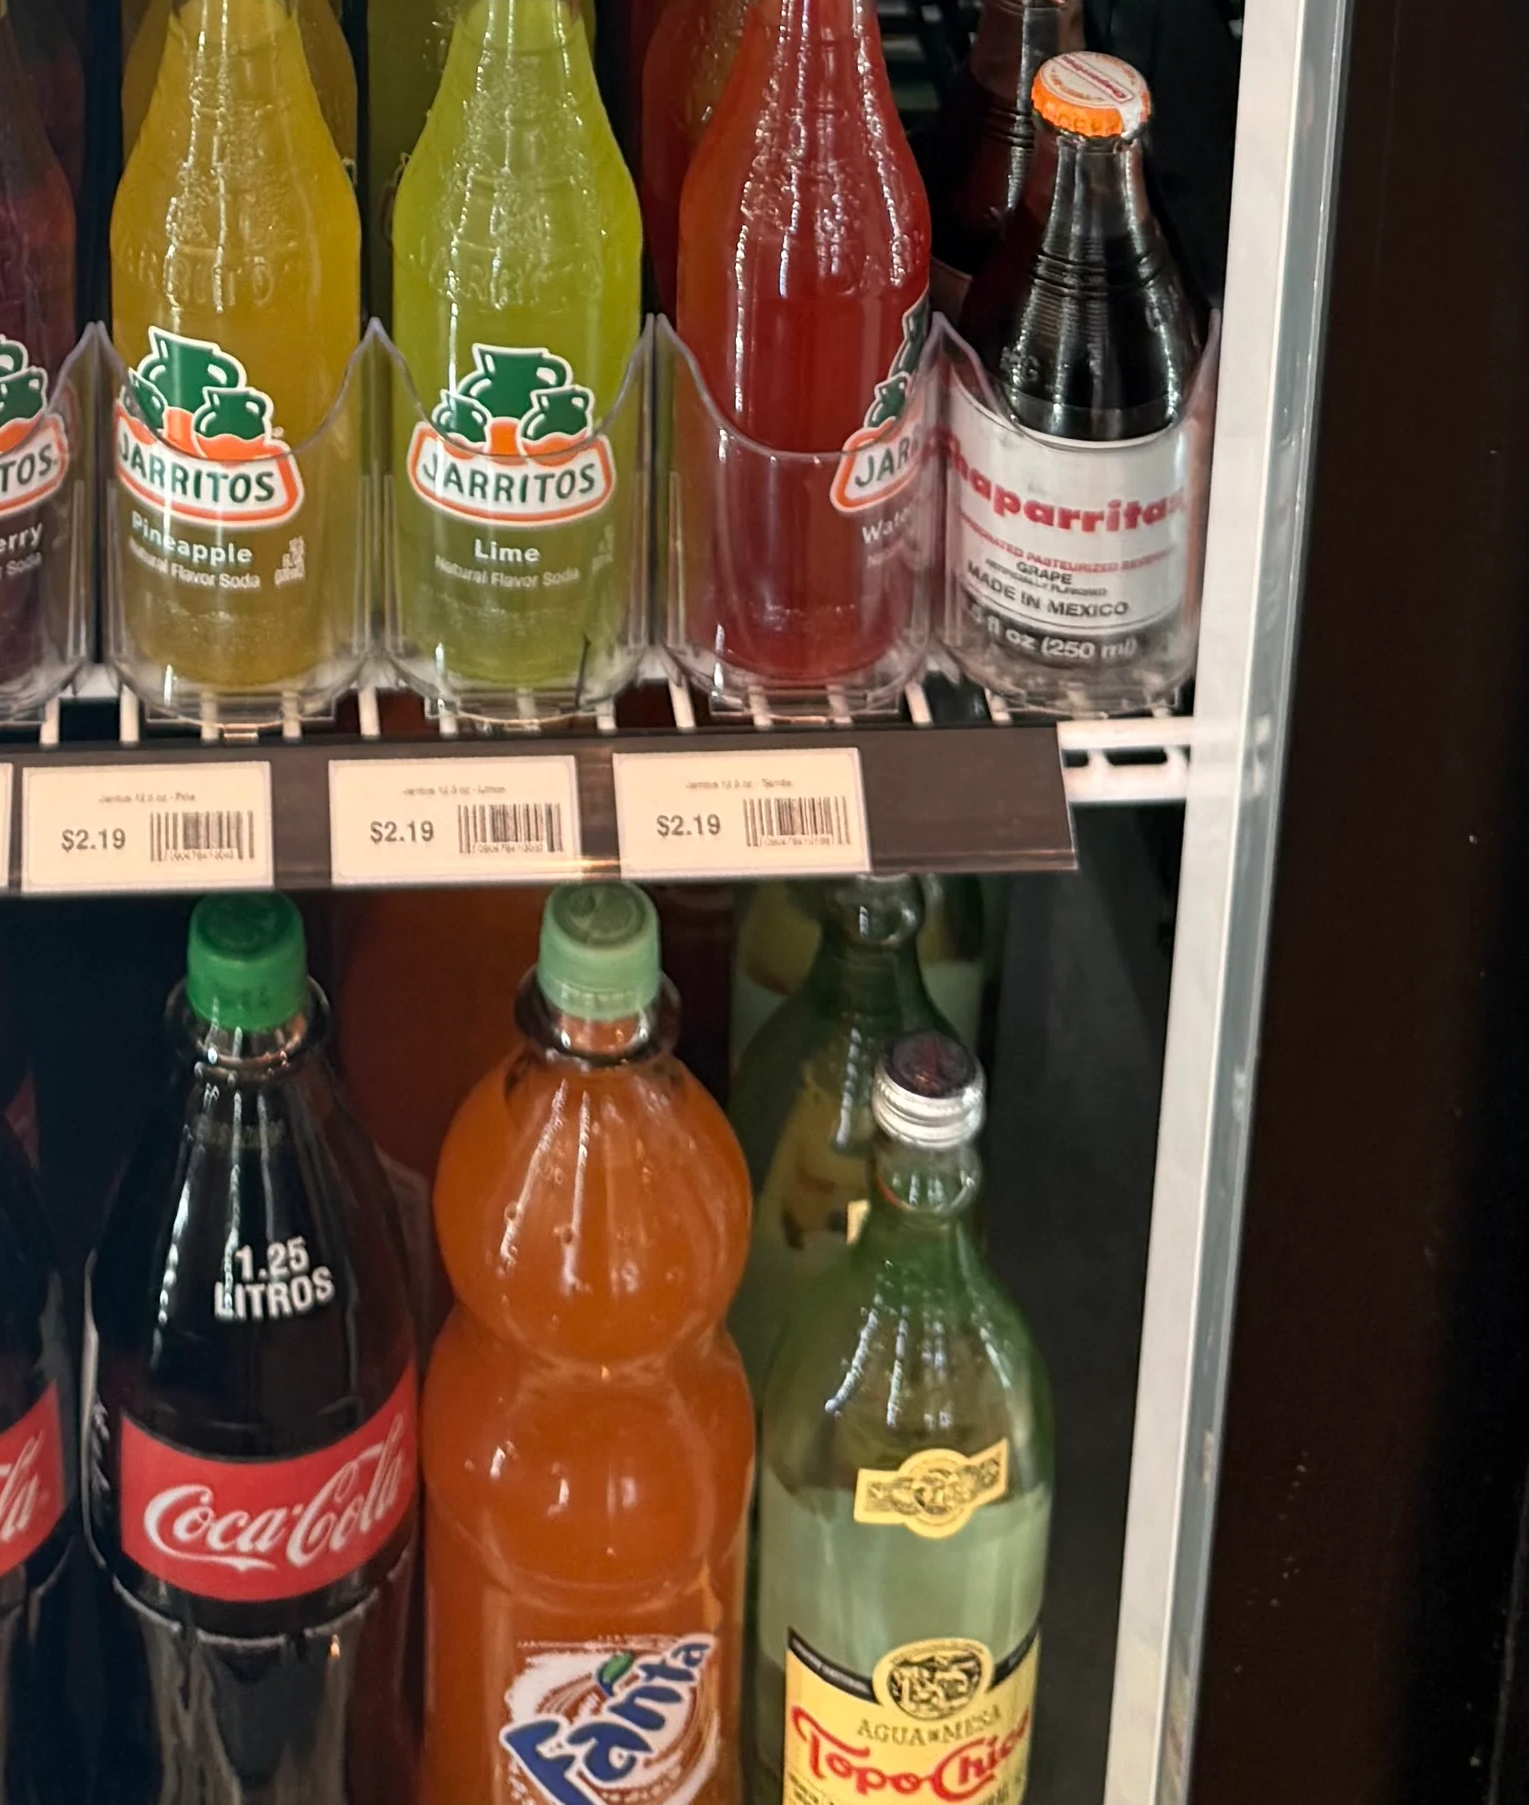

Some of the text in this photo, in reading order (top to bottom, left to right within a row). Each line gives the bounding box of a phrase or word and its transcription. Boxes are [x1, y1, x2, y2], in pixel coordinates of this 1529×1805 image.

[118, 432, 275, 504] JARRITOS
[422, 453, 596, 504] JARRITOS
[131, 510, 253, 567] Pineapple
[474, 538, 541, 562] Lime
[491, 567, 538, 589] Flavor
[1016, 560, 1073, 586] GRAPE
[1021, 591, 1130, 618] IN MEXICO
[1041, 632, 1095, 659] (250
[61, 827, 127, 853] $2.19
[369, 820, 435, 845] $2.19
[655, 813, 721, 838] $2.19
[235, 1235, 310, 1281] 1.25
[214, 1265, 335, 1322] LITROS
[143, 1412, 405, 1572] Coca-Cola
[502, 1641, 712, 1805] Fanta
[856, 1716, 930, 1748] AGUA
[790, 1704, 1031, 1804] Topo Chico
